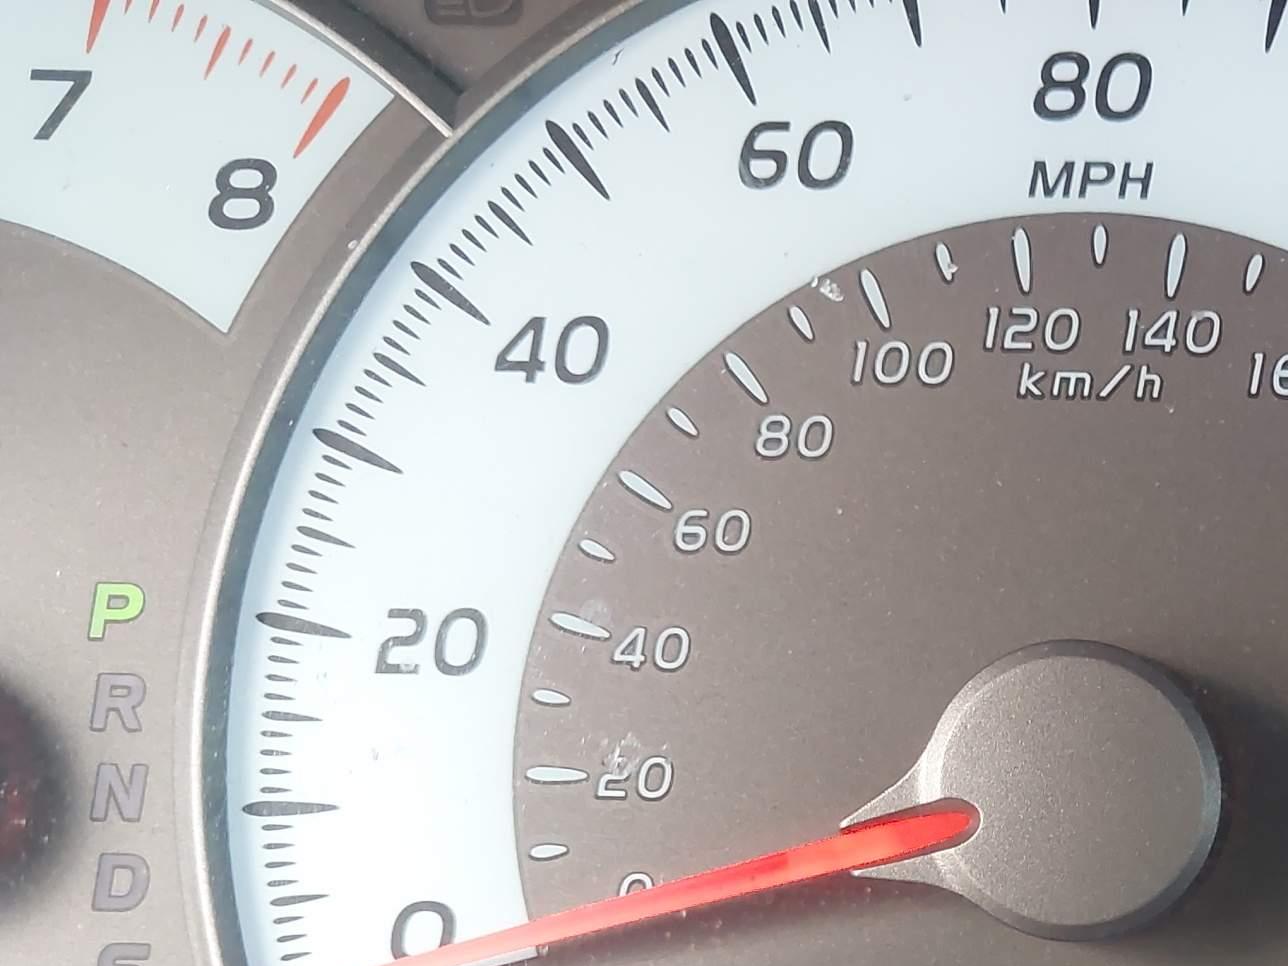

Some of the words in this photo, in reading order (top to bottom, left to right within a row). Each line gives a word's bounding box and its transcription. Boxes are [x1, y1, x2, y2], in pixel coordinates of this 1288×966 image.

[29, 69, 92, 141] 7
[1032, 51, 1153, 122] 80
[738, 120, 854, 191] 60
[1028, 160, 1154, 200] MPH
[207, 157, 279, 231] 8
[494, 314, 611, 386] 40
[983, 305, 1081, 352] 120
[1123, 308, 1222, 356] 140
[851, 339, 955, 387] 100
[1017, 362, 1164, 400] km/h
[754, 414, 835, 461] 80
[672, 508, 753, 554] 60
[88, 581, 146, 640] P
[373, 606, 489, 677] 20
[611, 626, 691, 673] 40
[88, 672, 148, 733] R
[89, 762, 149, 823] N
[593, 755, 674, 802] 20
[91, 852, 151, 913] D
[391, 900, 456, 960] 0
